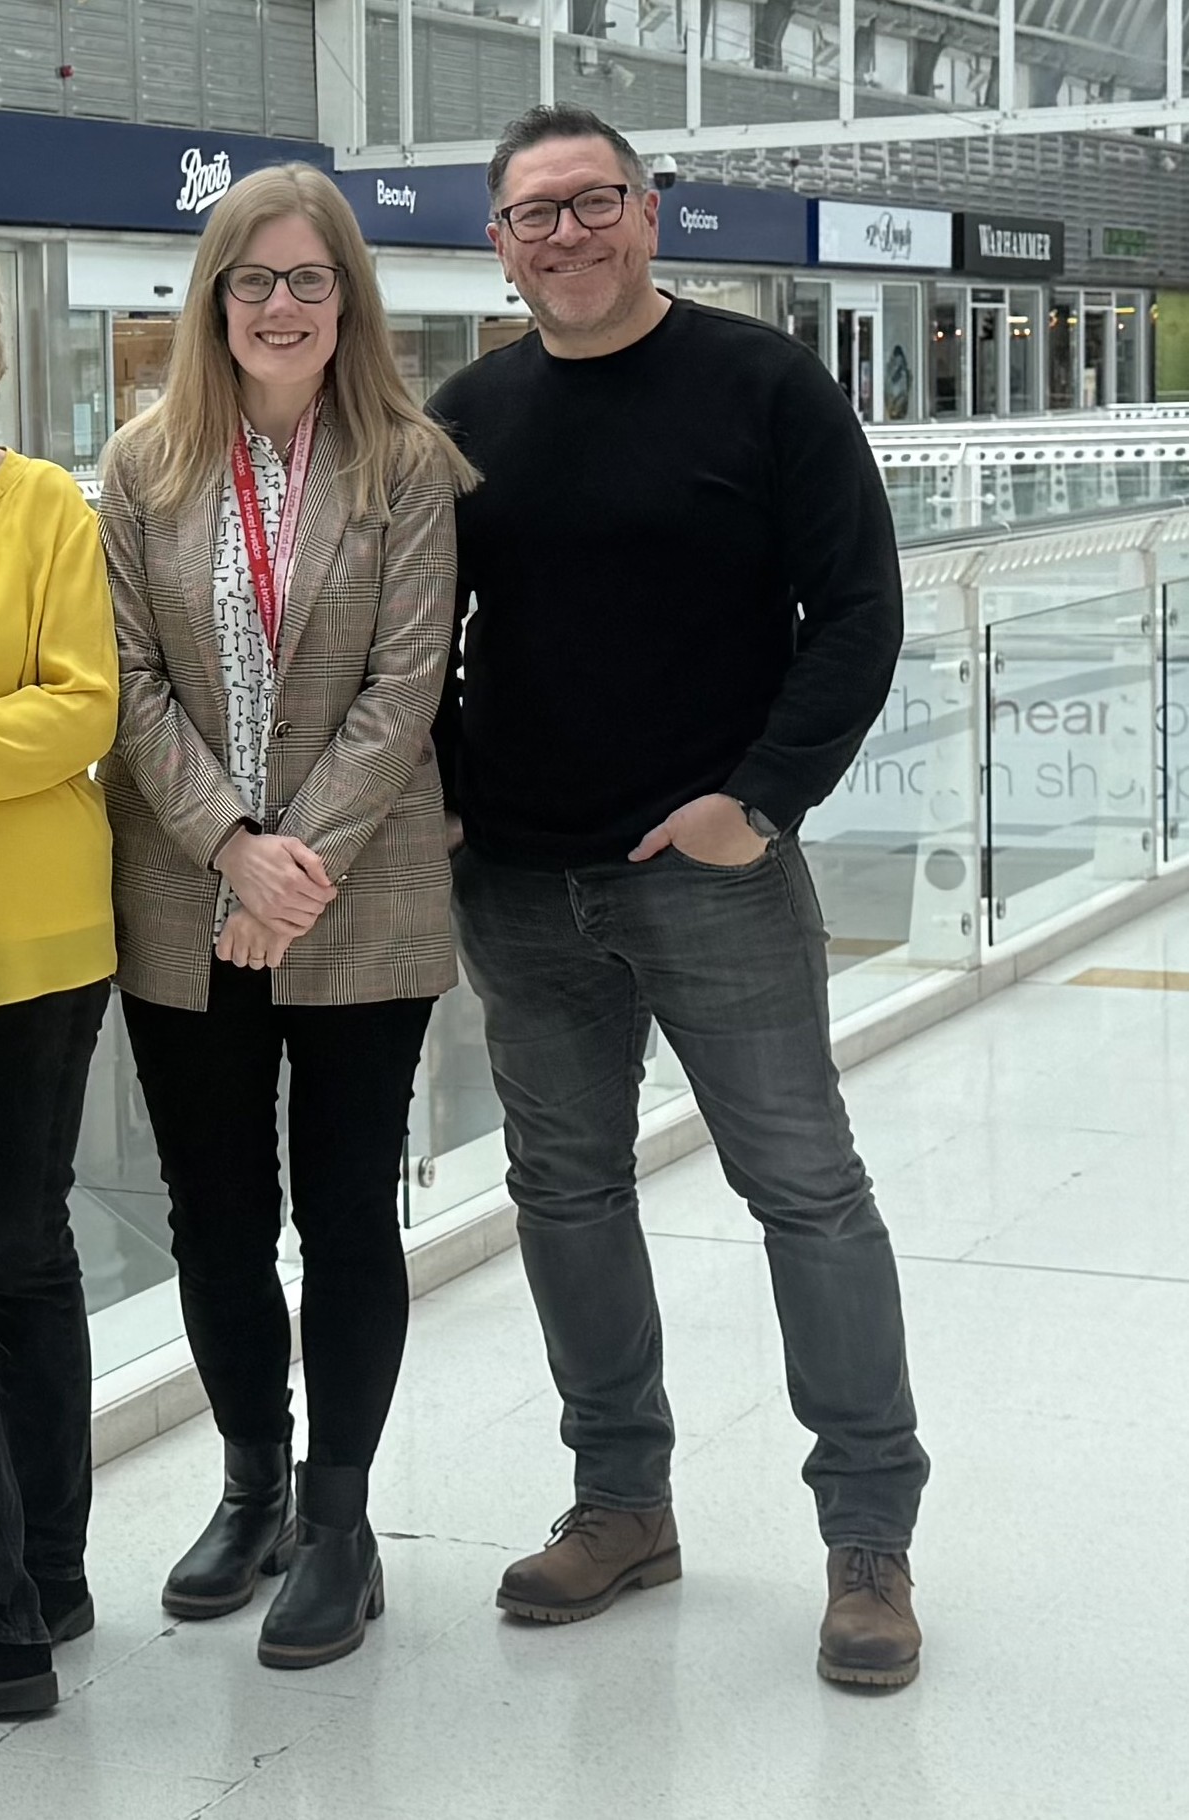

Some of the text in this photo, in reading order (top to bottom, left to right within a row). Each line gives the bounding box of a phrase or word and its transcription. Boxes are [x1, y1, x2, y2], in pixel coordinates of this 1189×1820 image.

[176, 148, 231, 214] Boots
[377, 178, 416, 214] Beauty
[978, 224, 1051, 261] WARHAMMER
[991, 687, 1138, 735] hear
